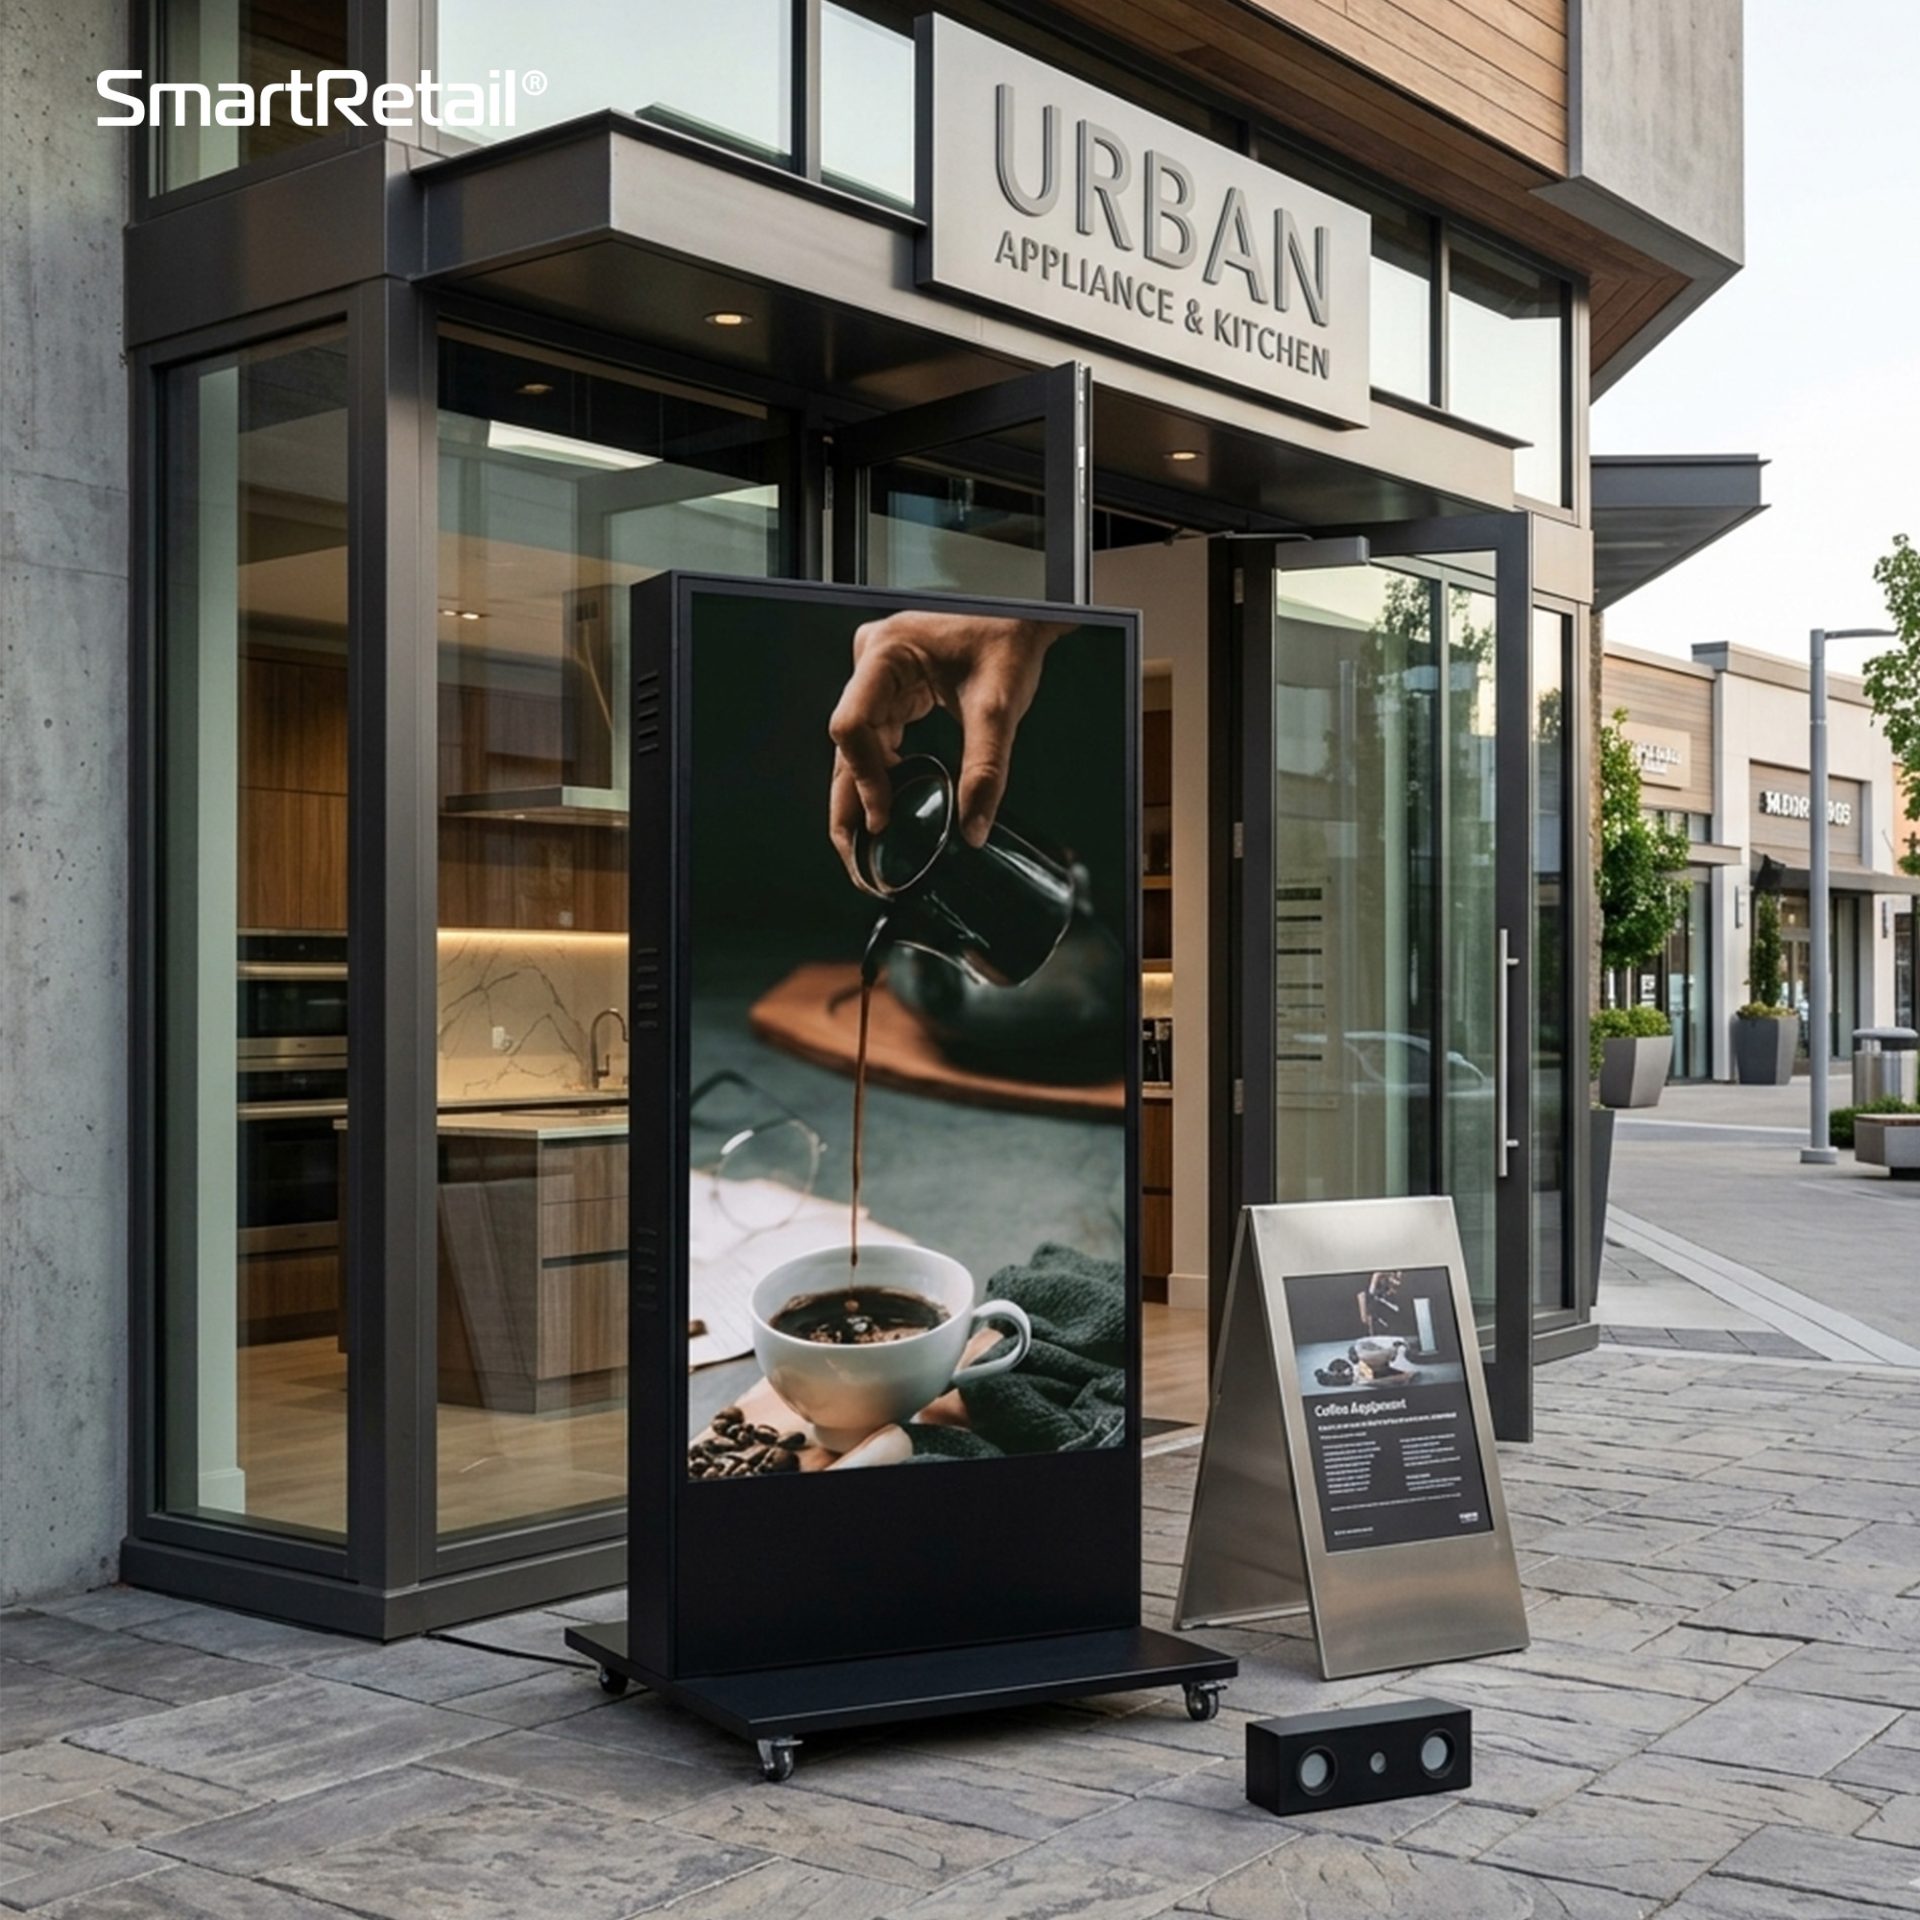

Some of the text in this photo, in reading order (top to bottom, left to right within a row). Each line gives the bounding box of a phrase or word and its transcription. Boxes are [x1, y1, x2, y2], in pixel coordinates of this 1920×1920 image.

[995, 83, 1330, 327] URBAN
[994, 230, 1330, 380] APPLIANCE & KITCHEN
